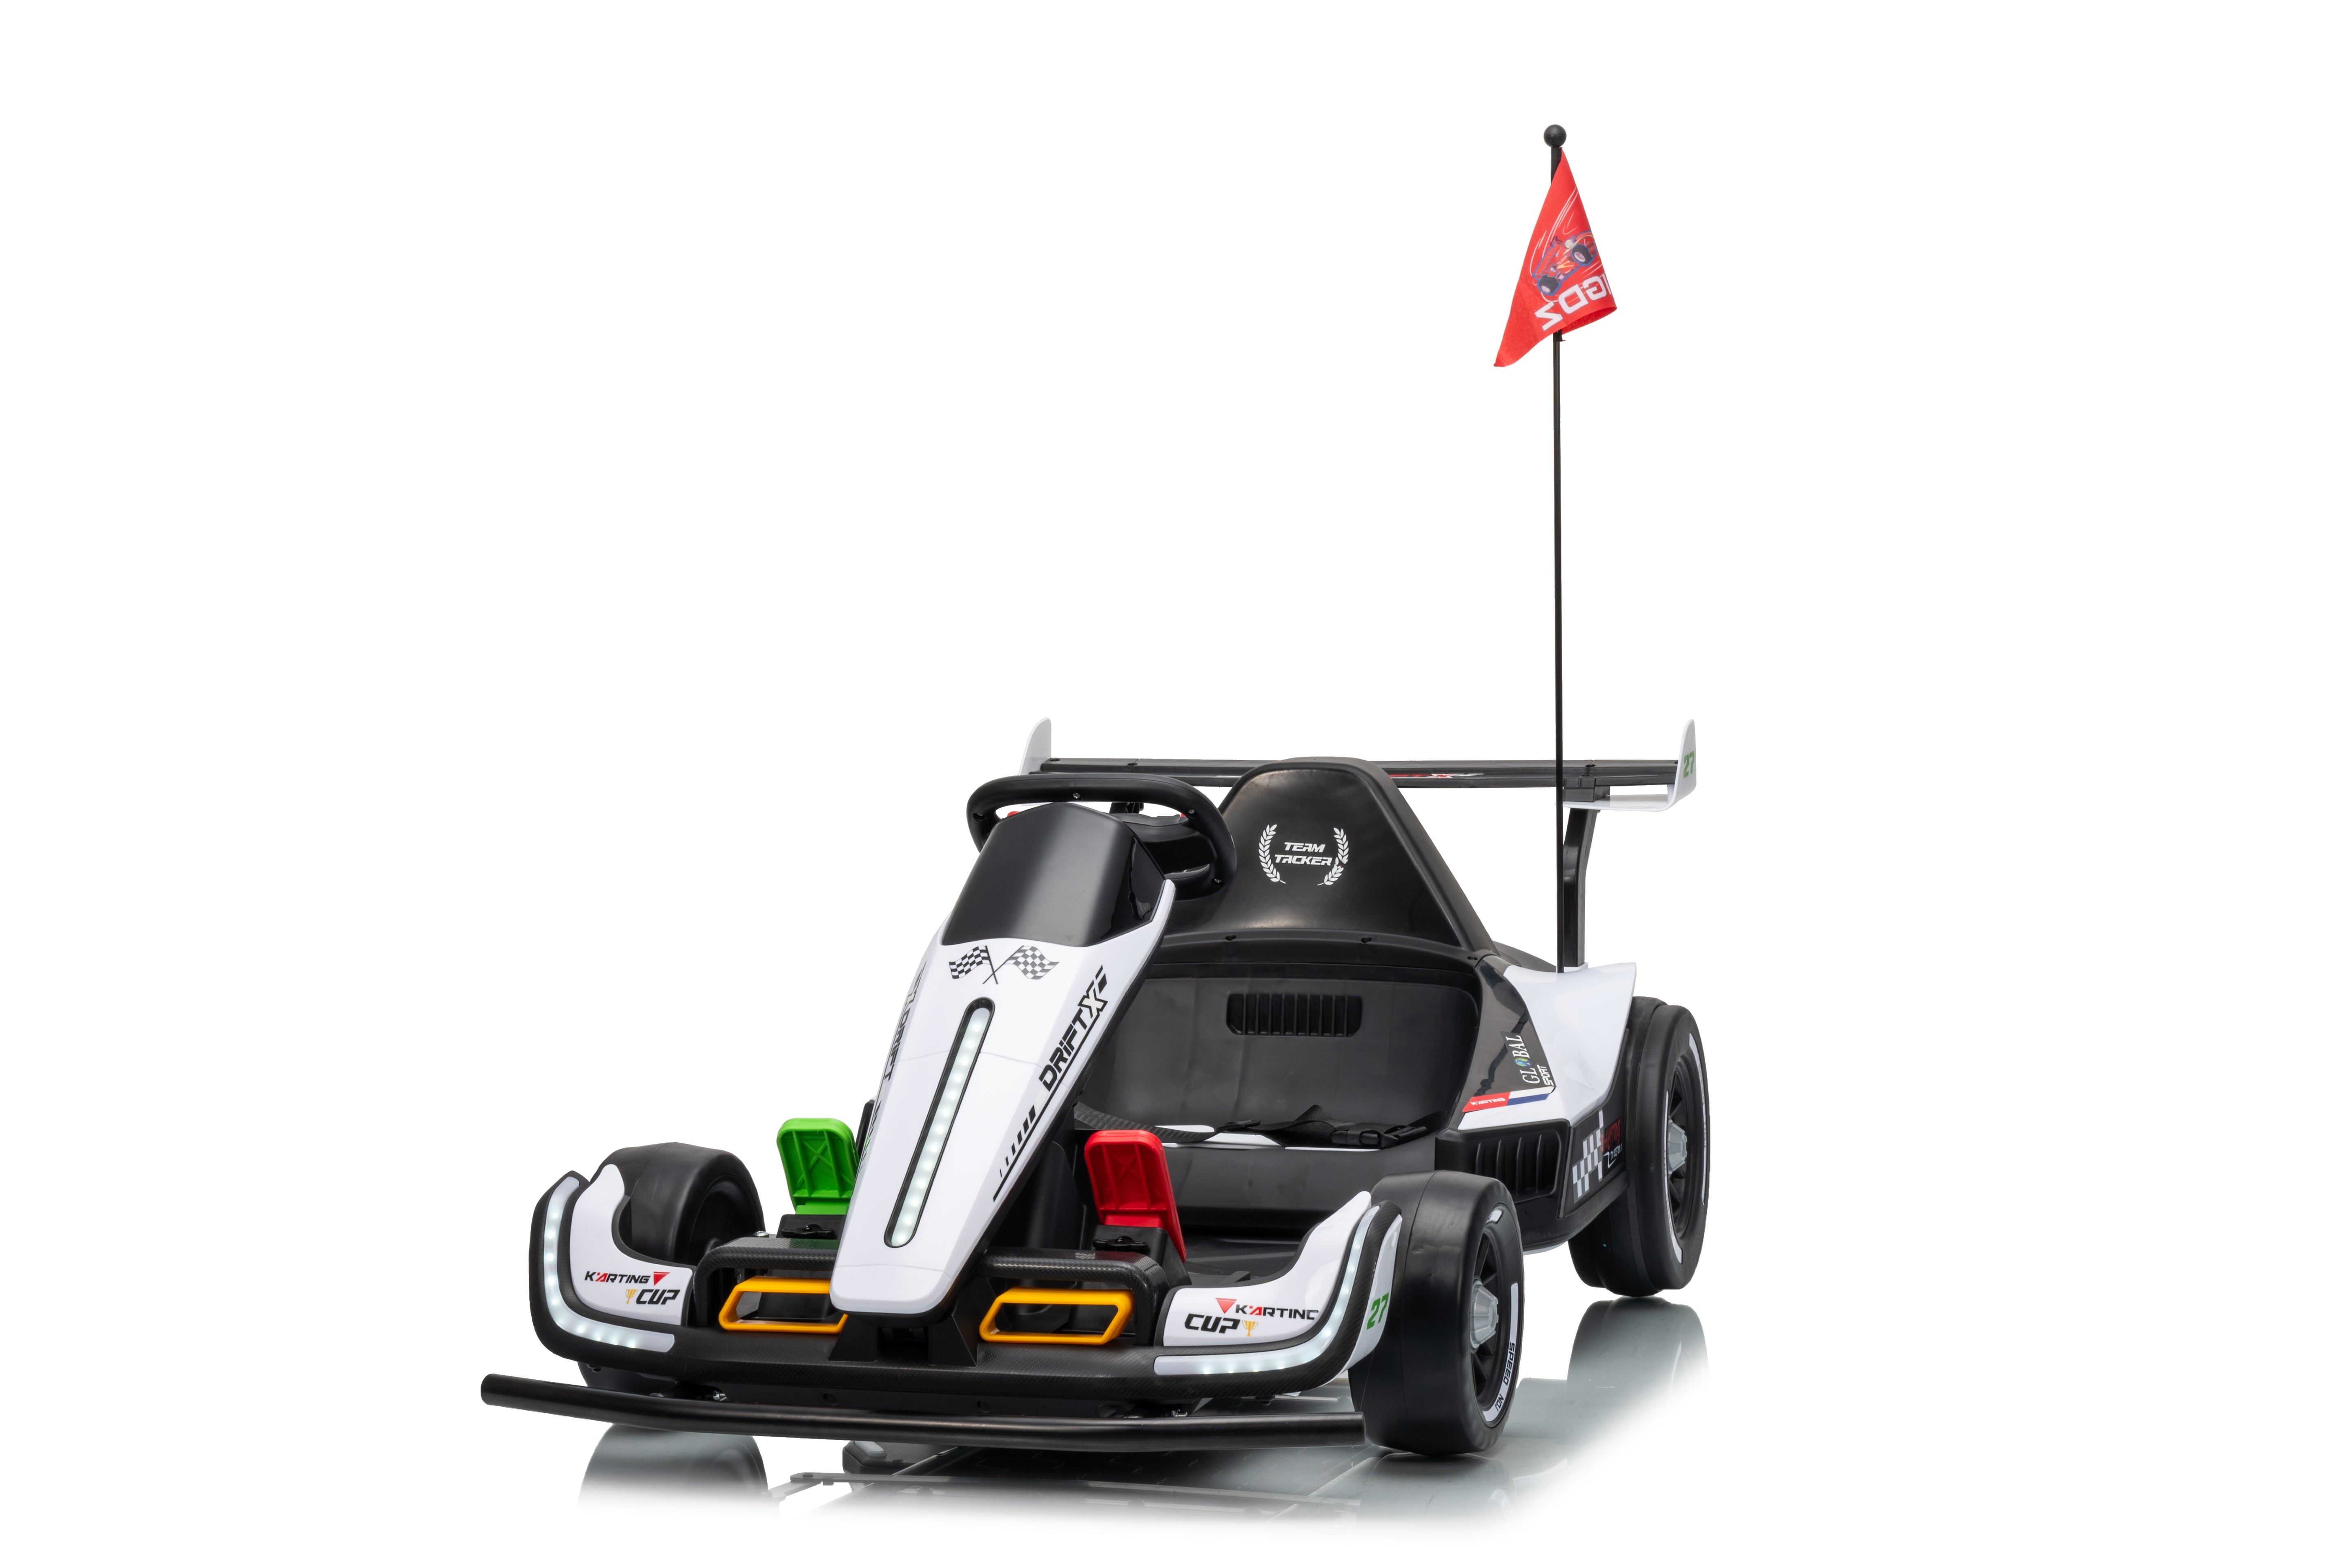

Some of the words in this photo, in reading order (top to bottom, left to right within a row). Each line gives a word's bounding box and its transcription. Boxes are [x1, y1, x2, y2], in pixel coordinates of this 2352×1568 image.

[1683, 751, 1695, 778] 27
[1284, 842, 1325, 853] TEAM
[1274, 854, 1332, 866] TACKER
[1537, 1064, 1554, 1086] SPORT
[636, 1289, 681, 1305] CUP
[1366, 1292, 1389, 1330] 27
[1184, 1313, 1241, 1334] CUP
[1503, 1342, 1515, 1386] SPEED
